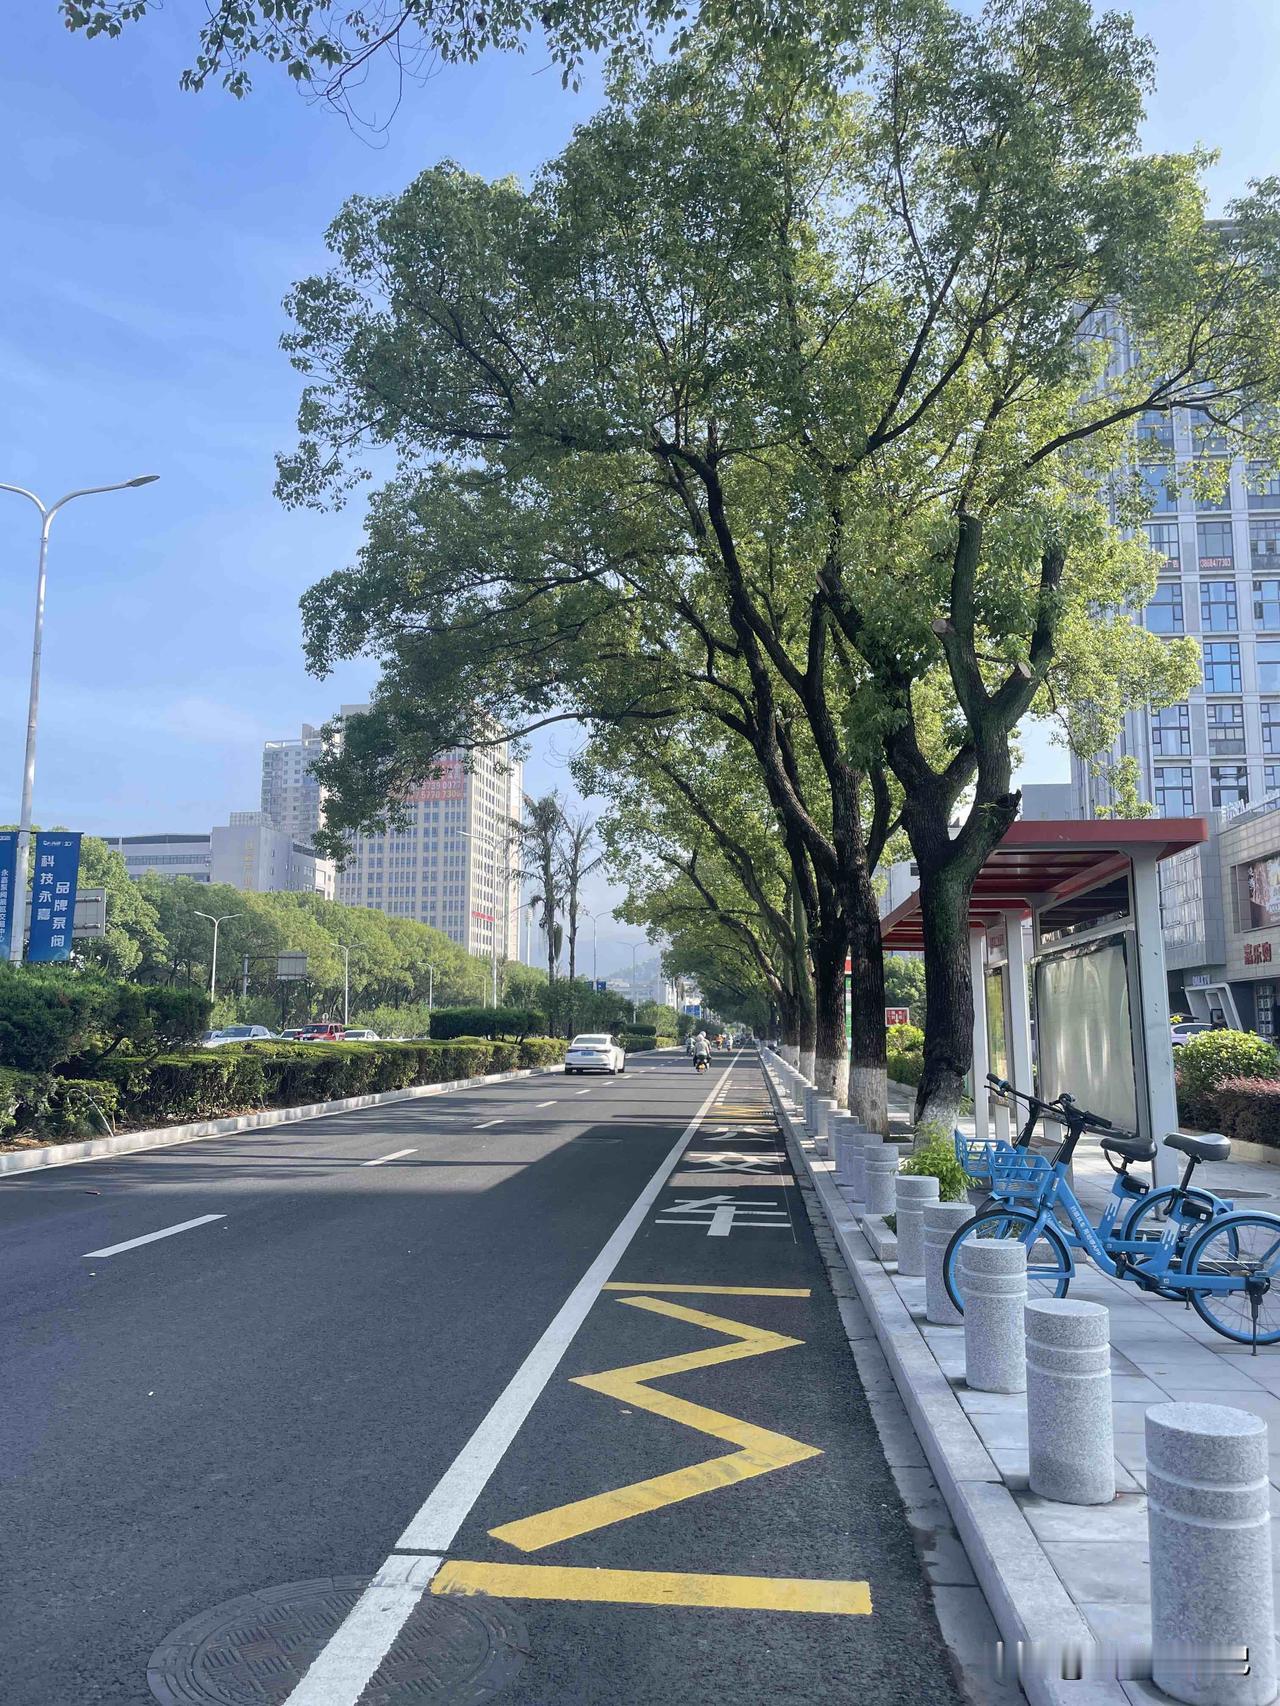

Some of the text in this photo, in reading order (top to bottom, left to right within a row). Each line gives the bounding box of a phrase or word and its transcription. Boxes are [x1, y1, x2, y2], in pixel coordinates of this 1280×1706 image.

[37, 855, 55, 921] 科技永嘉
[50, 881, 70, 948] 品牌泵阀
